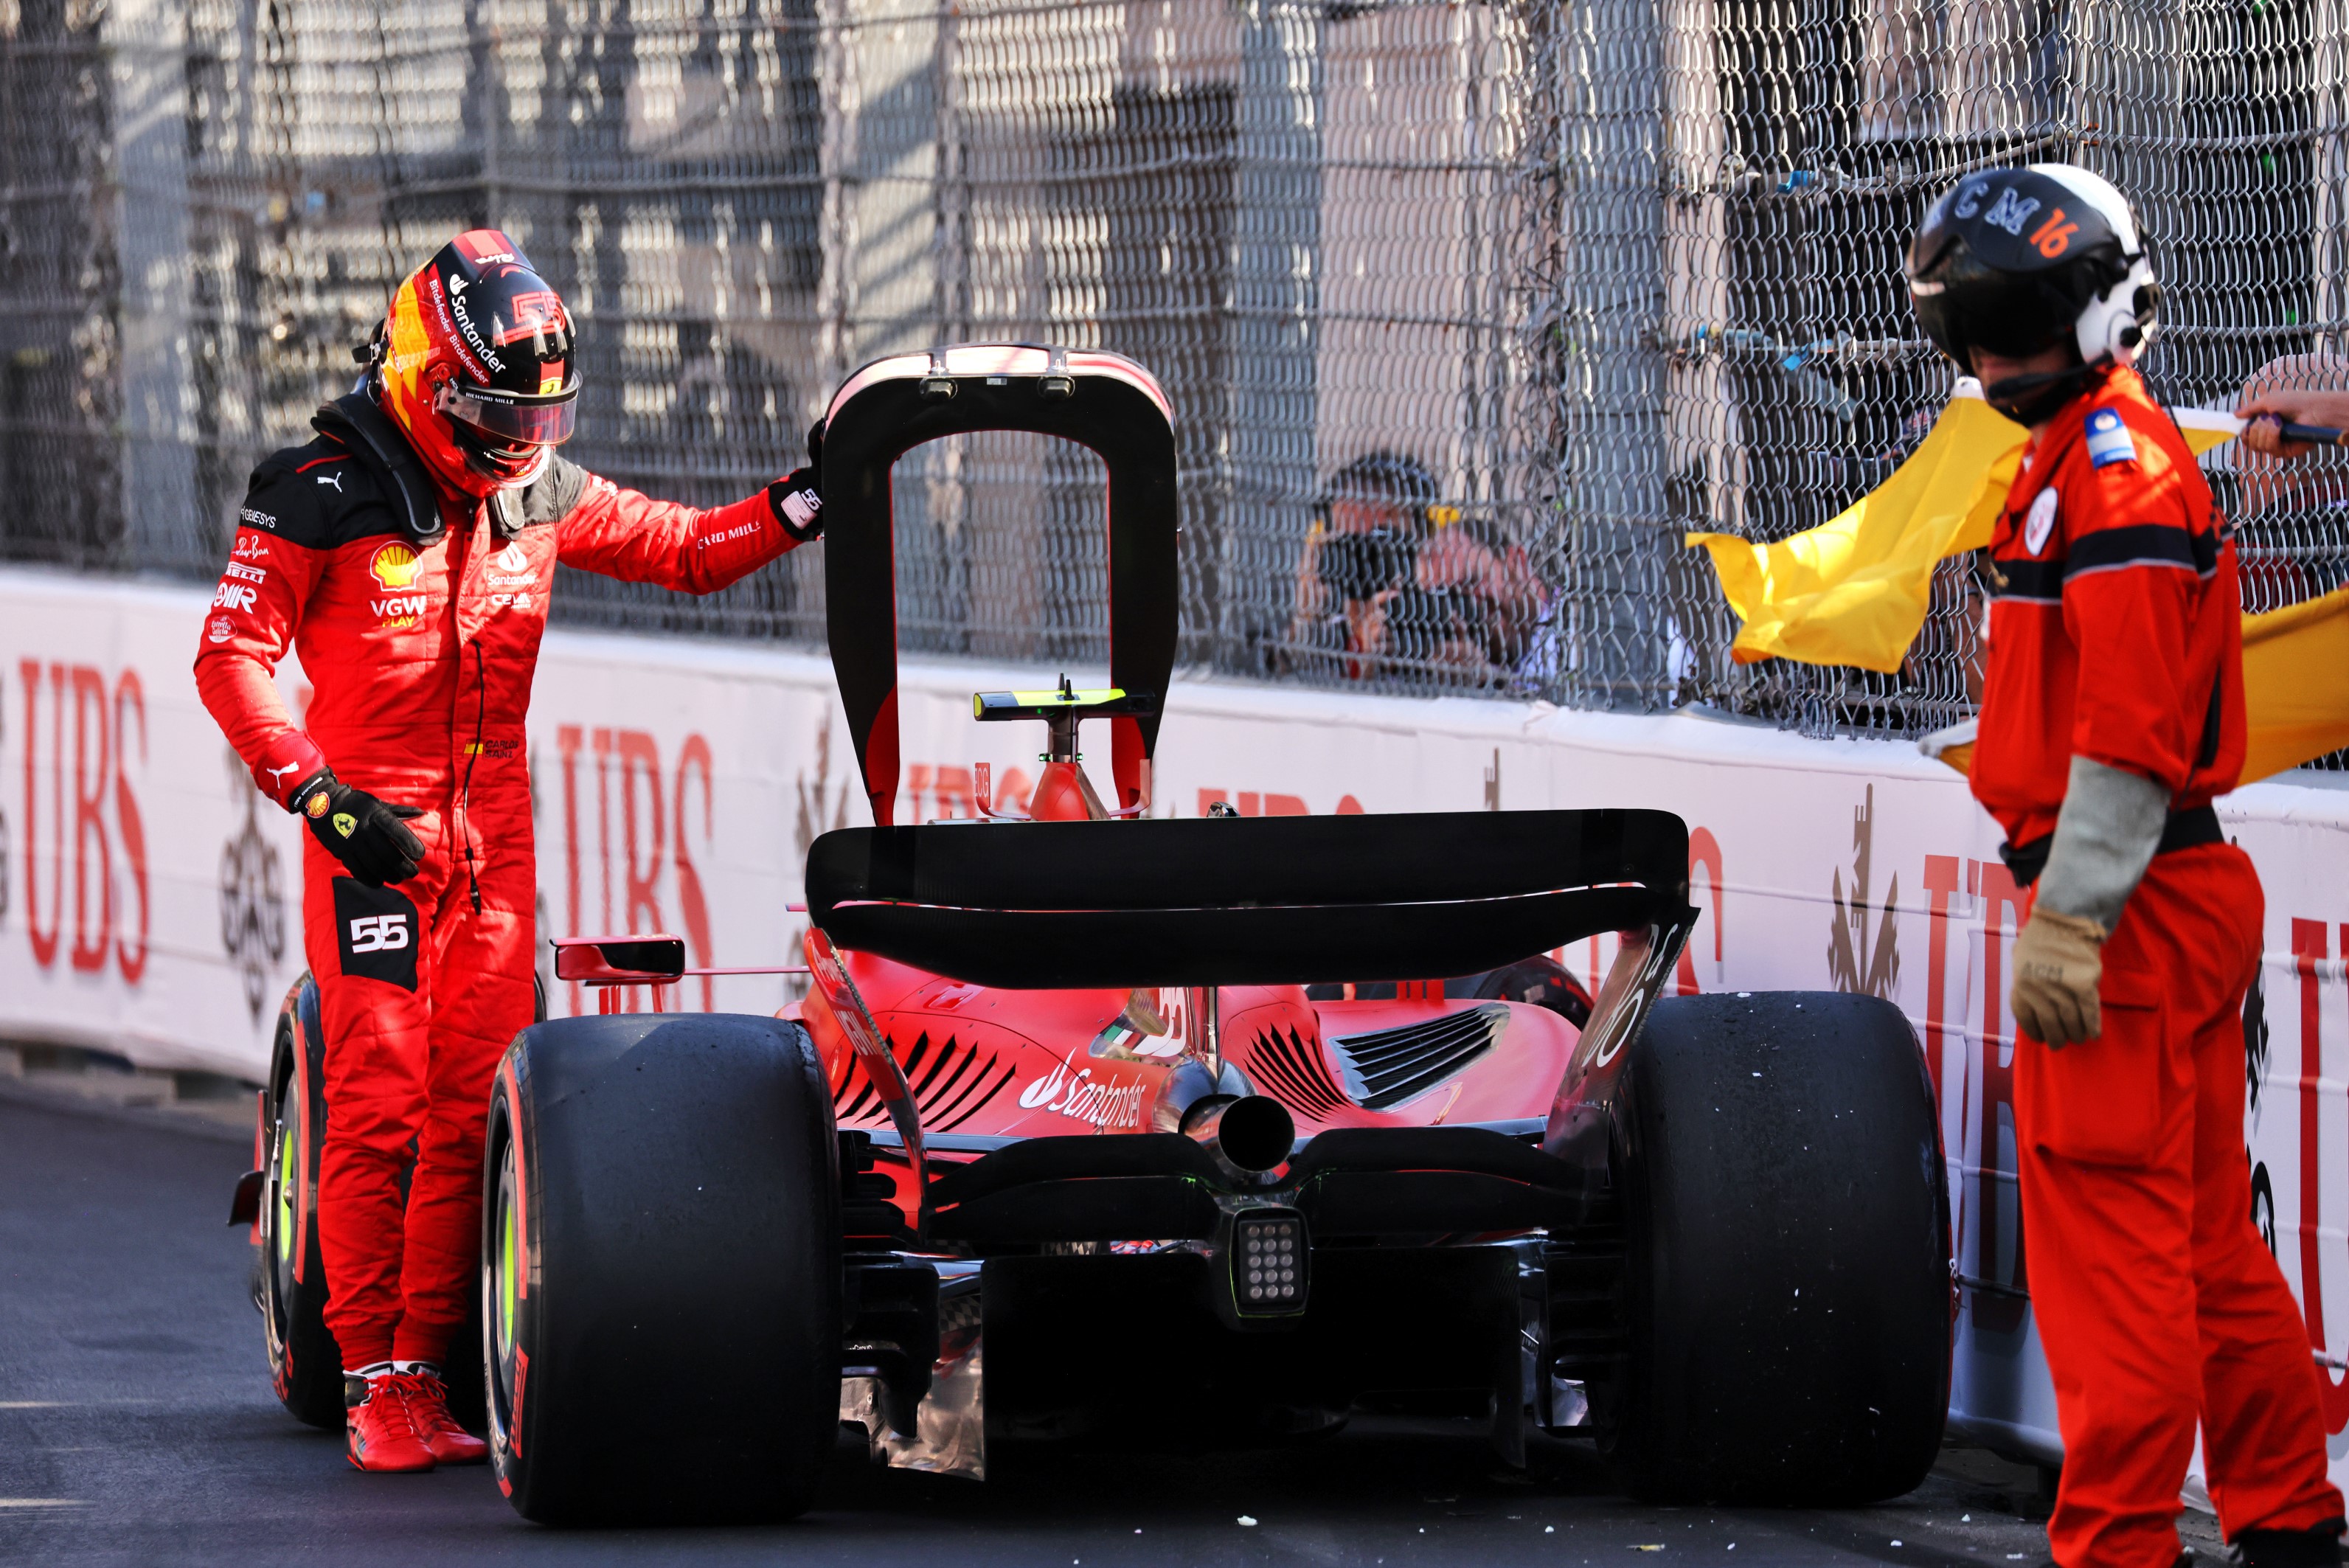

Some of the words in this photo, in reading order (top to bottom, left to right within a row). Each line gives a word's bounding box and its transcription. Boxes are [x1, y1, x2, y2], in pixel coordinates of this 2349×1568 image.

[2030, 207, 2079, 259] 16
[428, 278, 451, 333] Bitdefender
[448, 333, 489, 384] Bitdefender
[451, 295, 506, 373] Santander
[465, 392, 493, 403] RICHARD
[494, 398, 515, 406] MILLE
[800, 488, 823, 511] 55
[488, 573, 536, 586] Santander
[369, 595, 427, 617] VGW
[382, 616, 415, 628] PLAY
[485, 740, 519, 750] CARLOS
[485, 750, 513, 759] SAINZ
[18, 655, 150, 985] UBS
[555, 721, 715, 1015] UBS
[350, 914, 409, 954] 55
[1047, 1068, 1147, 1128] Santander
